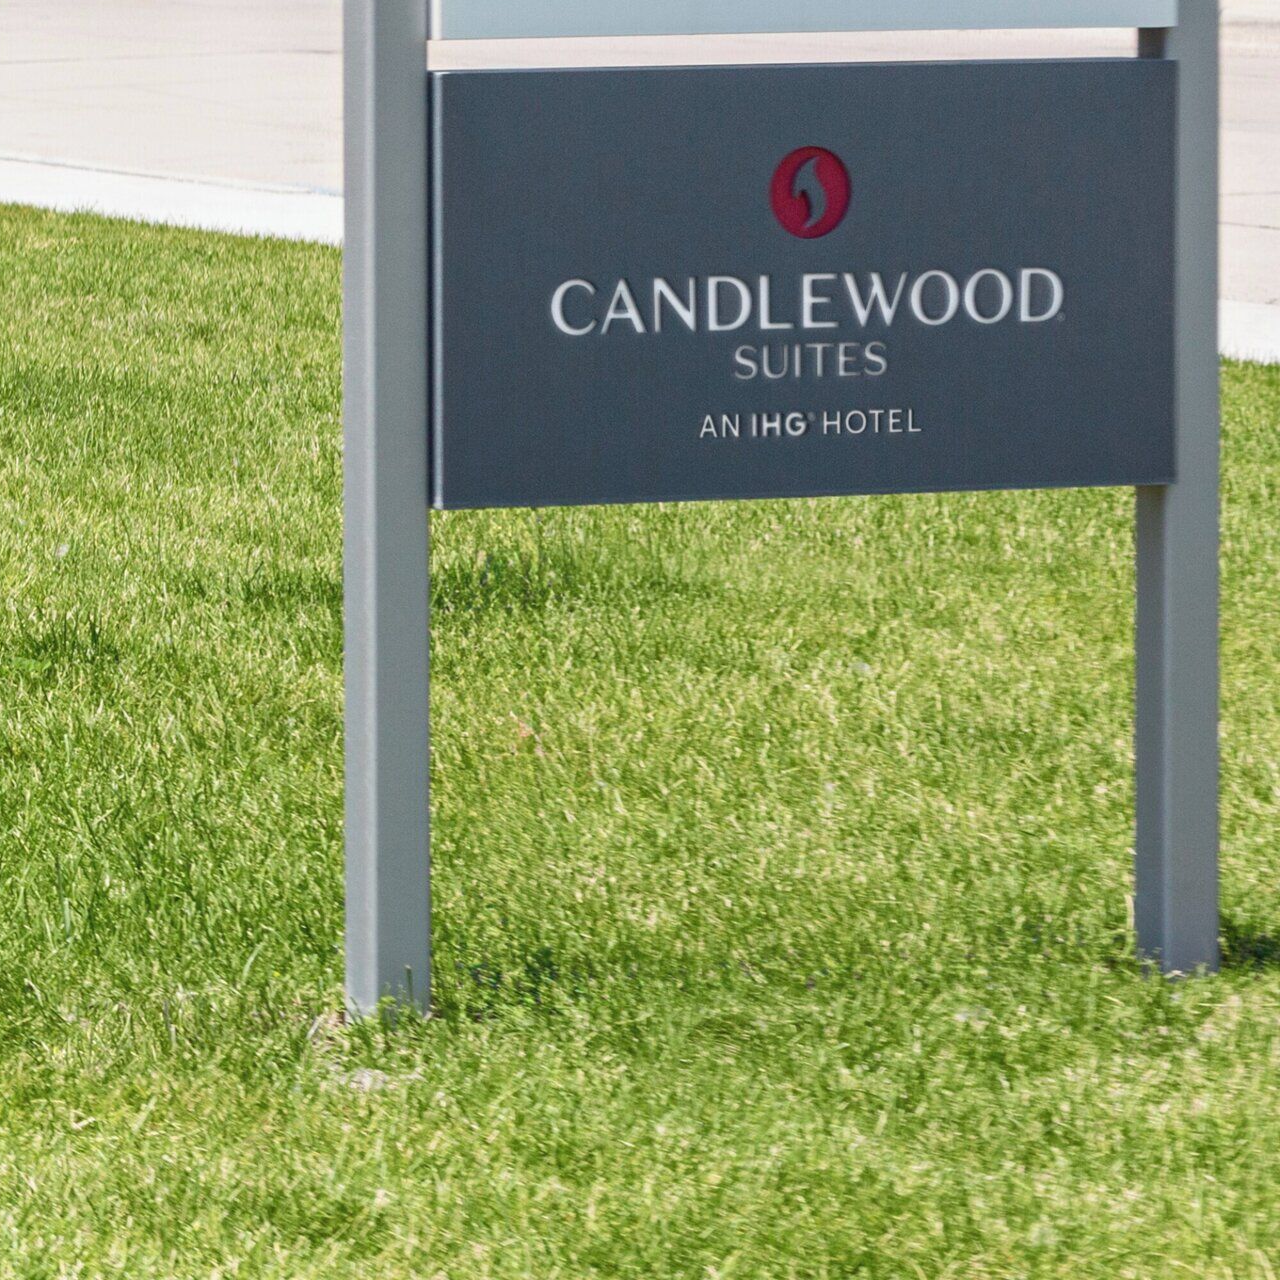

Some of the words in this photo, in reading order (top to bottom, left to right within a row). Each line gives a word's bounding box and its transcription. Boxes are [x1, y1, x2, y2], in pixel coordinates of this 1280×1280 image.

[550, 267, 1065, 336] CANDLEWOOD
[733, 341, 889, 380] SUITES
[699, 413, 740, 439] AN
[823, 408, 923, 435] HOTEL
